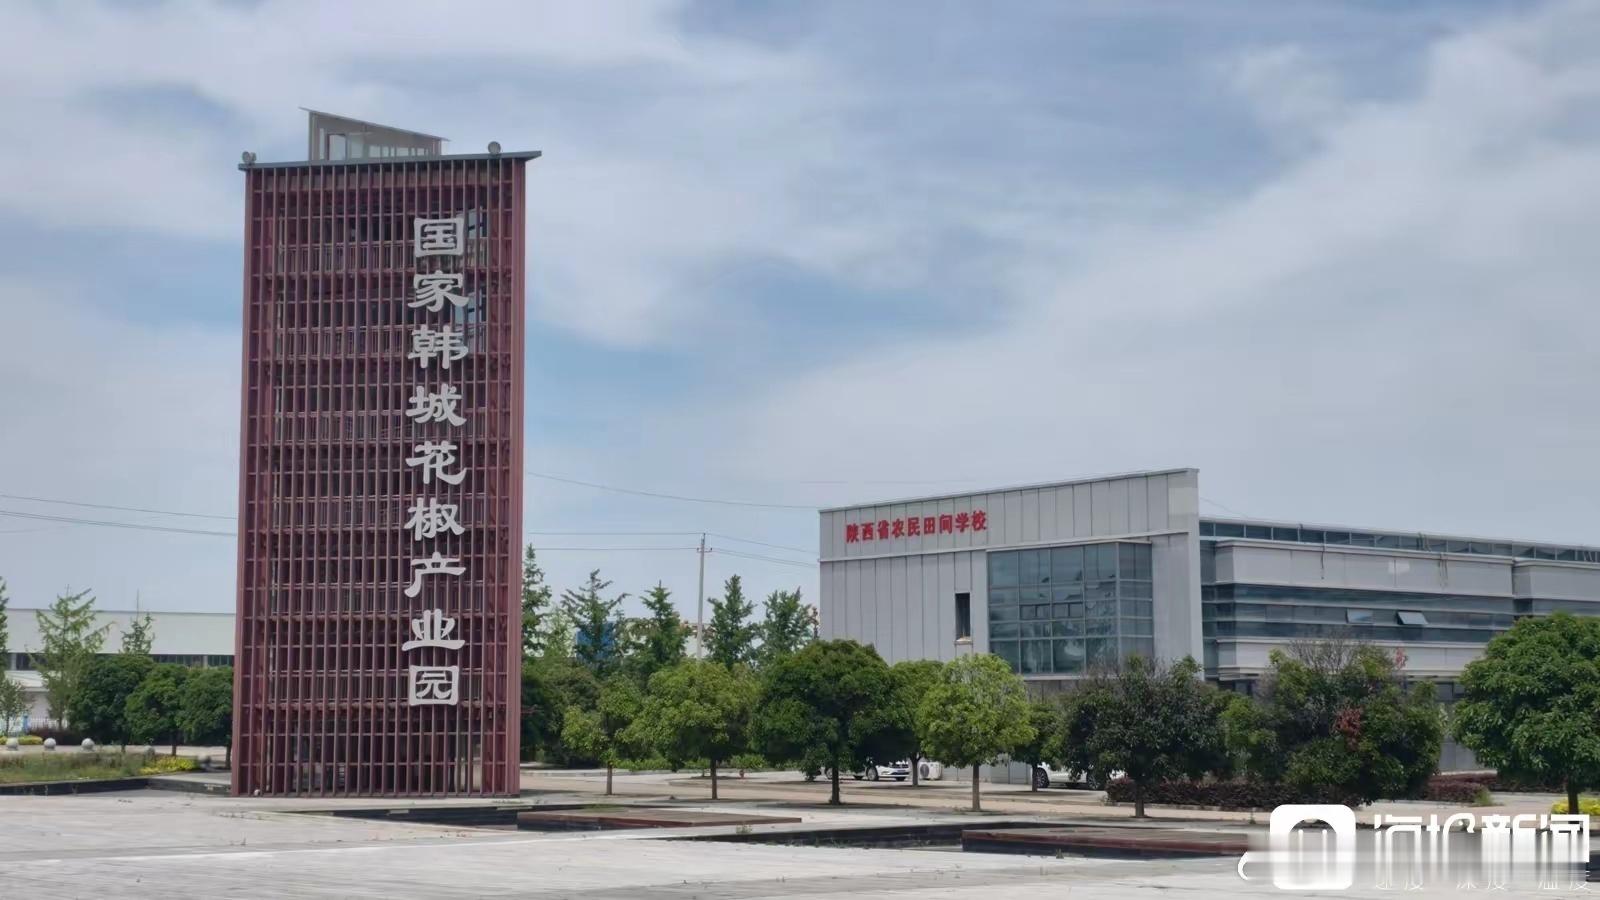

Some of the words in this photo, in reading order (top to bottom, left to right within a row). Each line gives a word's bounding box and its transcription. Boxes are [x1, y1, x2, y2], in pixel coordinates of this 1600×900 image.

[401, 217, 470, 706] 国家韩城花椒产业园
[845, 510, 988, 543] 陕西省农民田间学校
